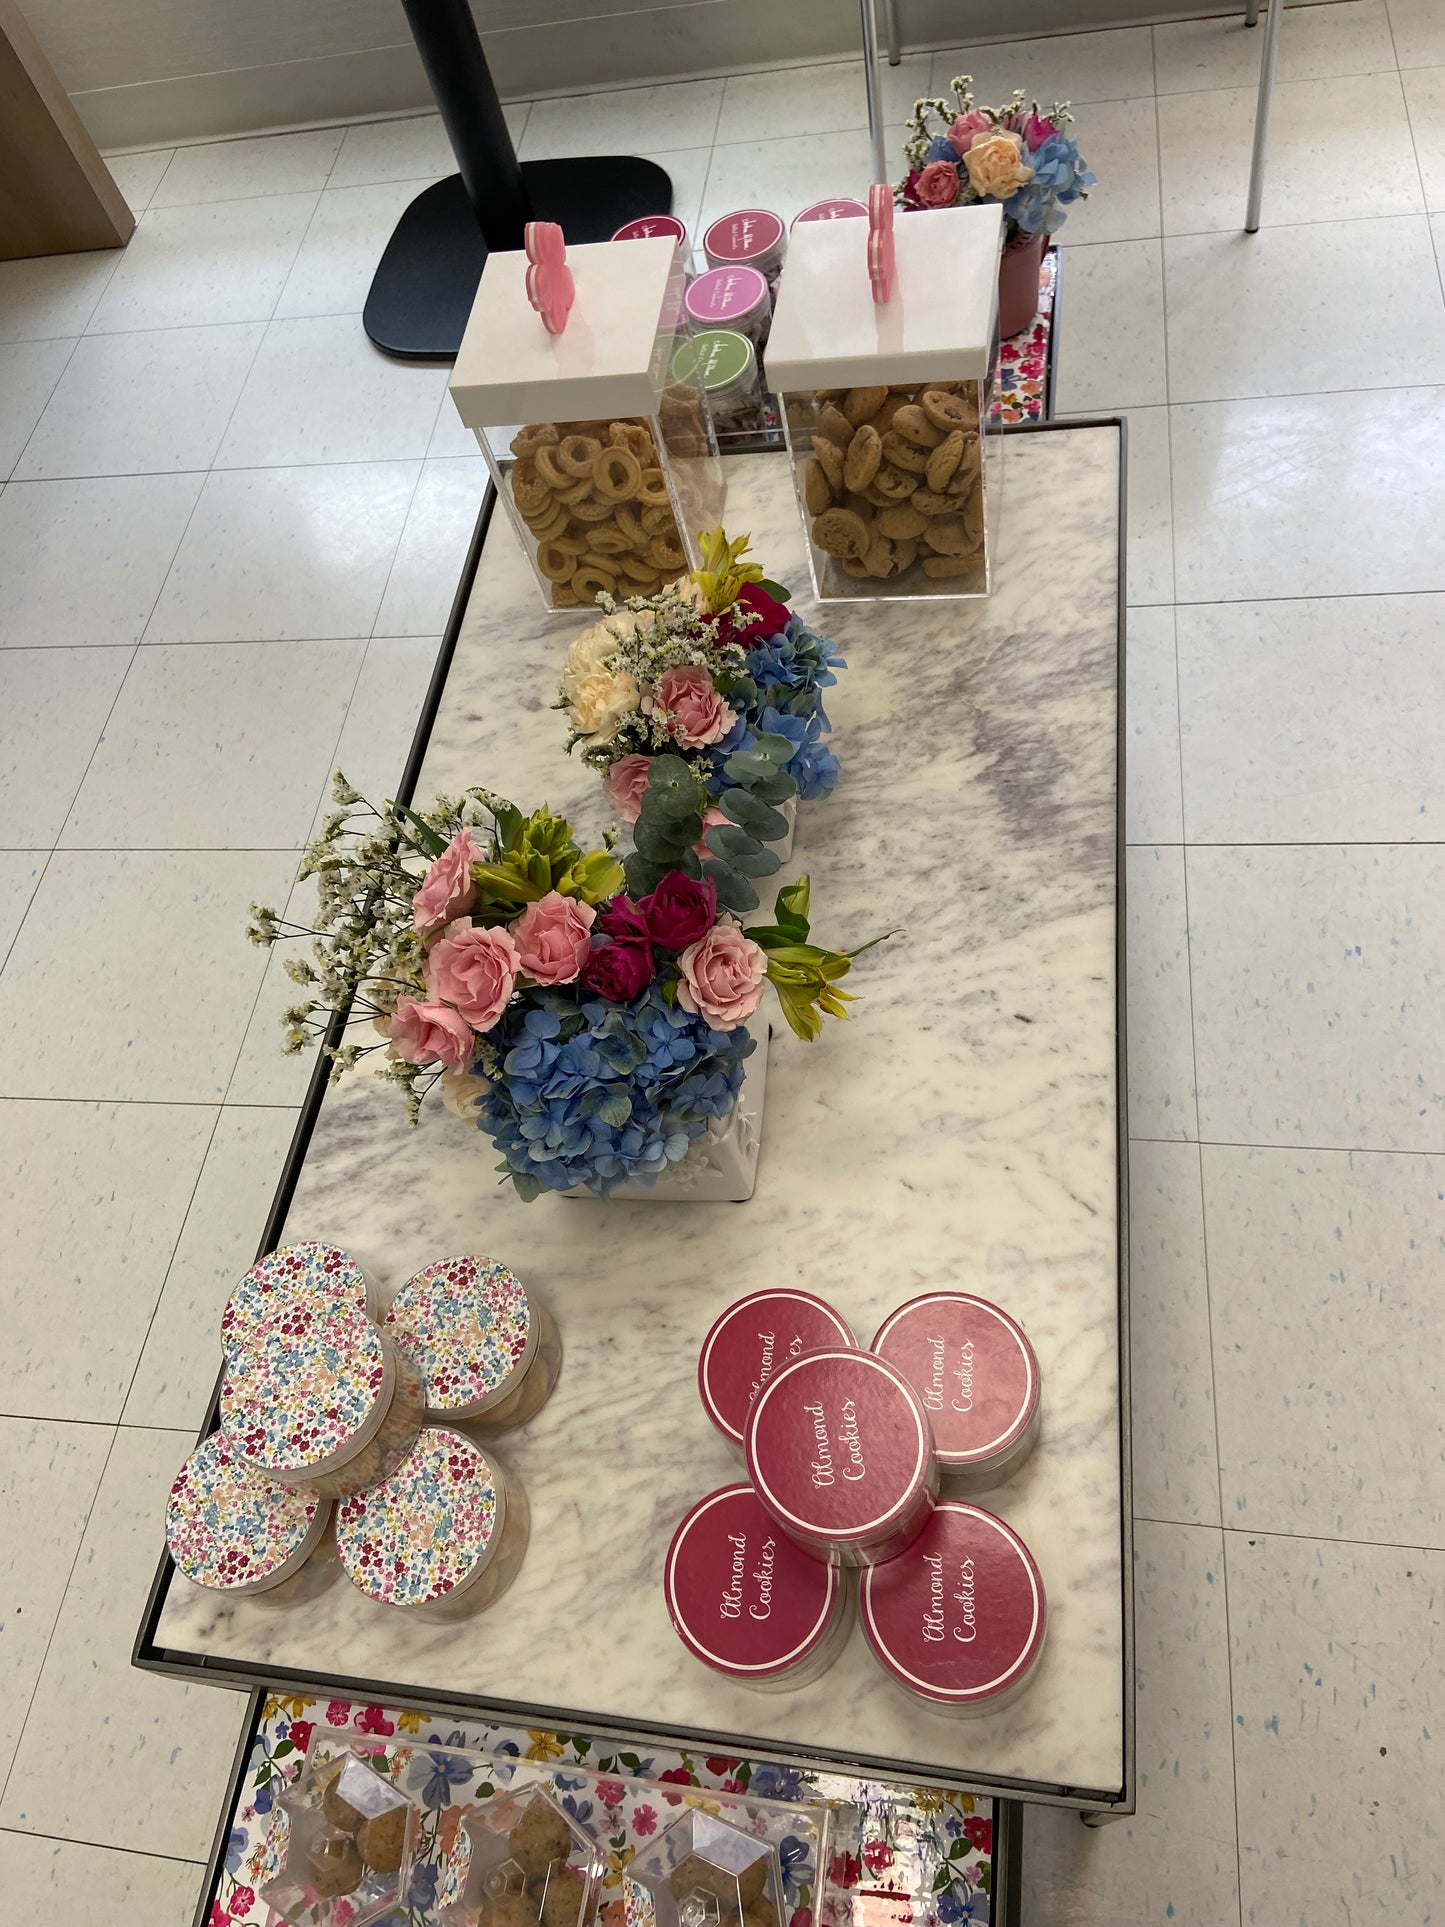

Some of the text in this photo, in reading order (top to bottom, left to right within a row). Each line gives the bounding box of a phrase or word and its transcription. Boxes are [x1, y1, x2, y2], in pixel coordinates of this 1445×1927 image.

[921, 1335, 944, 1411] Almond
[952, 1339, 975, 1412] Cookies
[804, 1401, 835, 1489] Almond
[839, 1397, 866, 1481] Cookies
[720, 1532, 747, 1619] Almond
[748, 1536, 776, 1620] Cookies
[922, 1552, 944, 1642] Almond
[953, 1555, 976, 1642] Cookies
